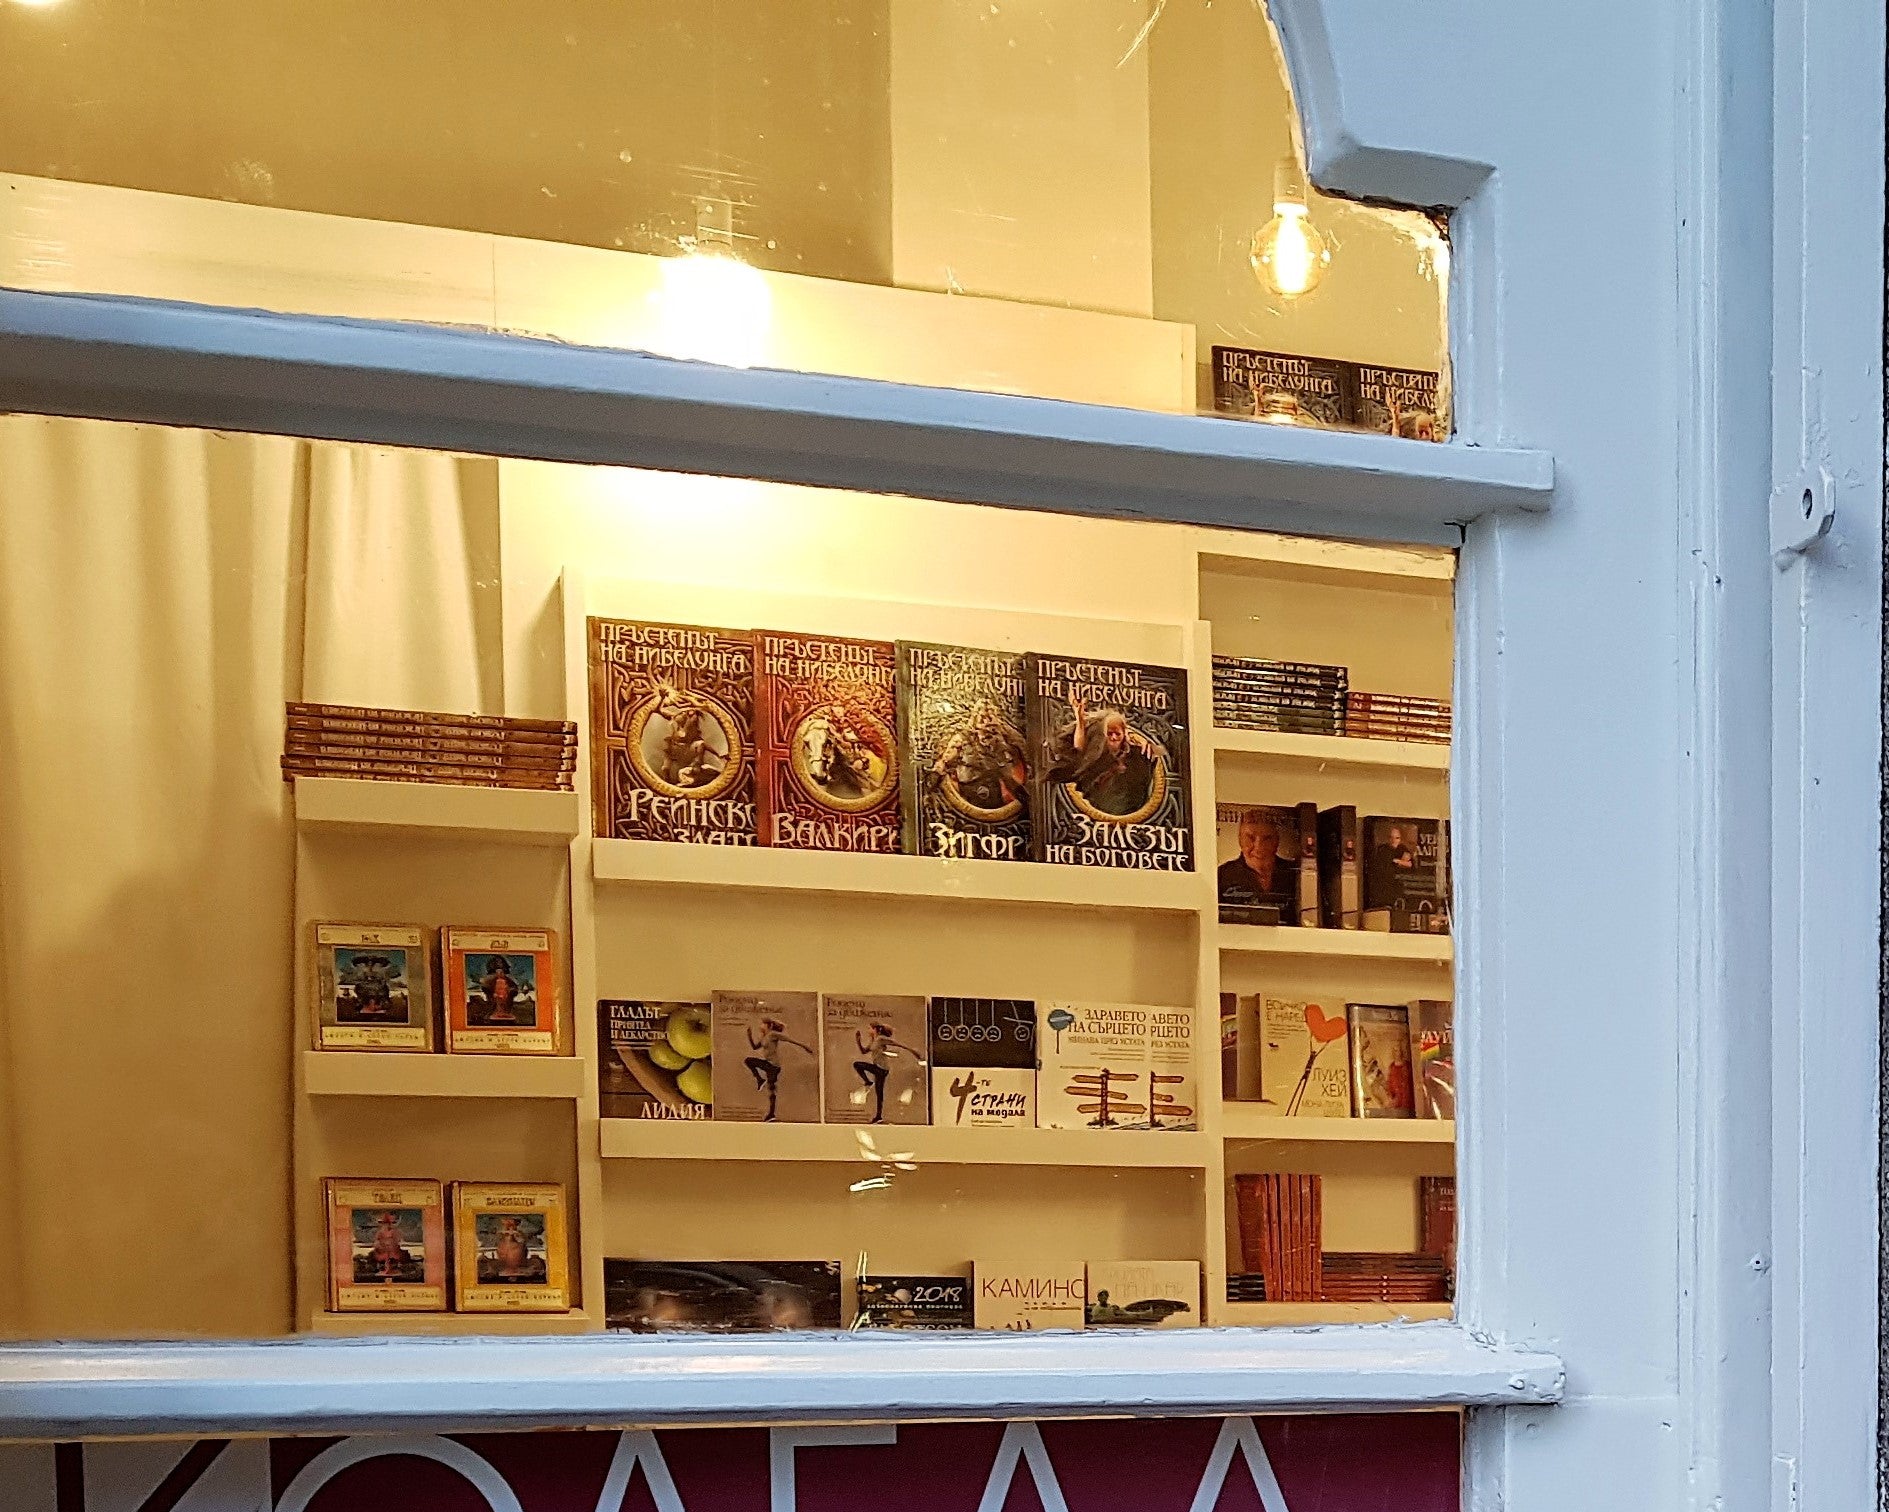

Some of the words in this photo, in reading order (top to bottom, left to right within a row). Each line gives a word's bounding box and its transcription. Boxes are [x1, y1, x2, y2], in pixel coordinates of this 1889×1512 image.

[1223, 366, 1244, 384] НА
[1360, 367, 1439, 390] ПРЪСТЕН
[1360, 382, 1381, 401] НА
[599, 622, 720, 650] ПРЪСТЕНЪТ
[600, 642, 628, 664] НА
[634, 645, 748, 674] НИБЕЛУНГА
[764, 636, 879, 665] ПРЪСТЕНЪТ
[765, 656, 791, 677] НА
[1037, 659, 1143, 688] ПРЪСТЕНЪТ
[1037, 677, 1064, 699] НА
[1068, 681, 1168, 711] НИБЕЛУНГА
[1070, 812, 1189, 854] ЗАЛЕЗЪТ
[1045, 844, 1075, 865] НА
[1081, 847, 1190, 873] БОГОВЕТЕ
[1085, 1008, 1147, 1023] ЗДРАВЕТО
[1087, 1021, 1147, 1036] СЪРЦЕТО
[970, 1092, 1027, 1109] СТРАНИ
[913, 1286, 963, 1302] 2018
